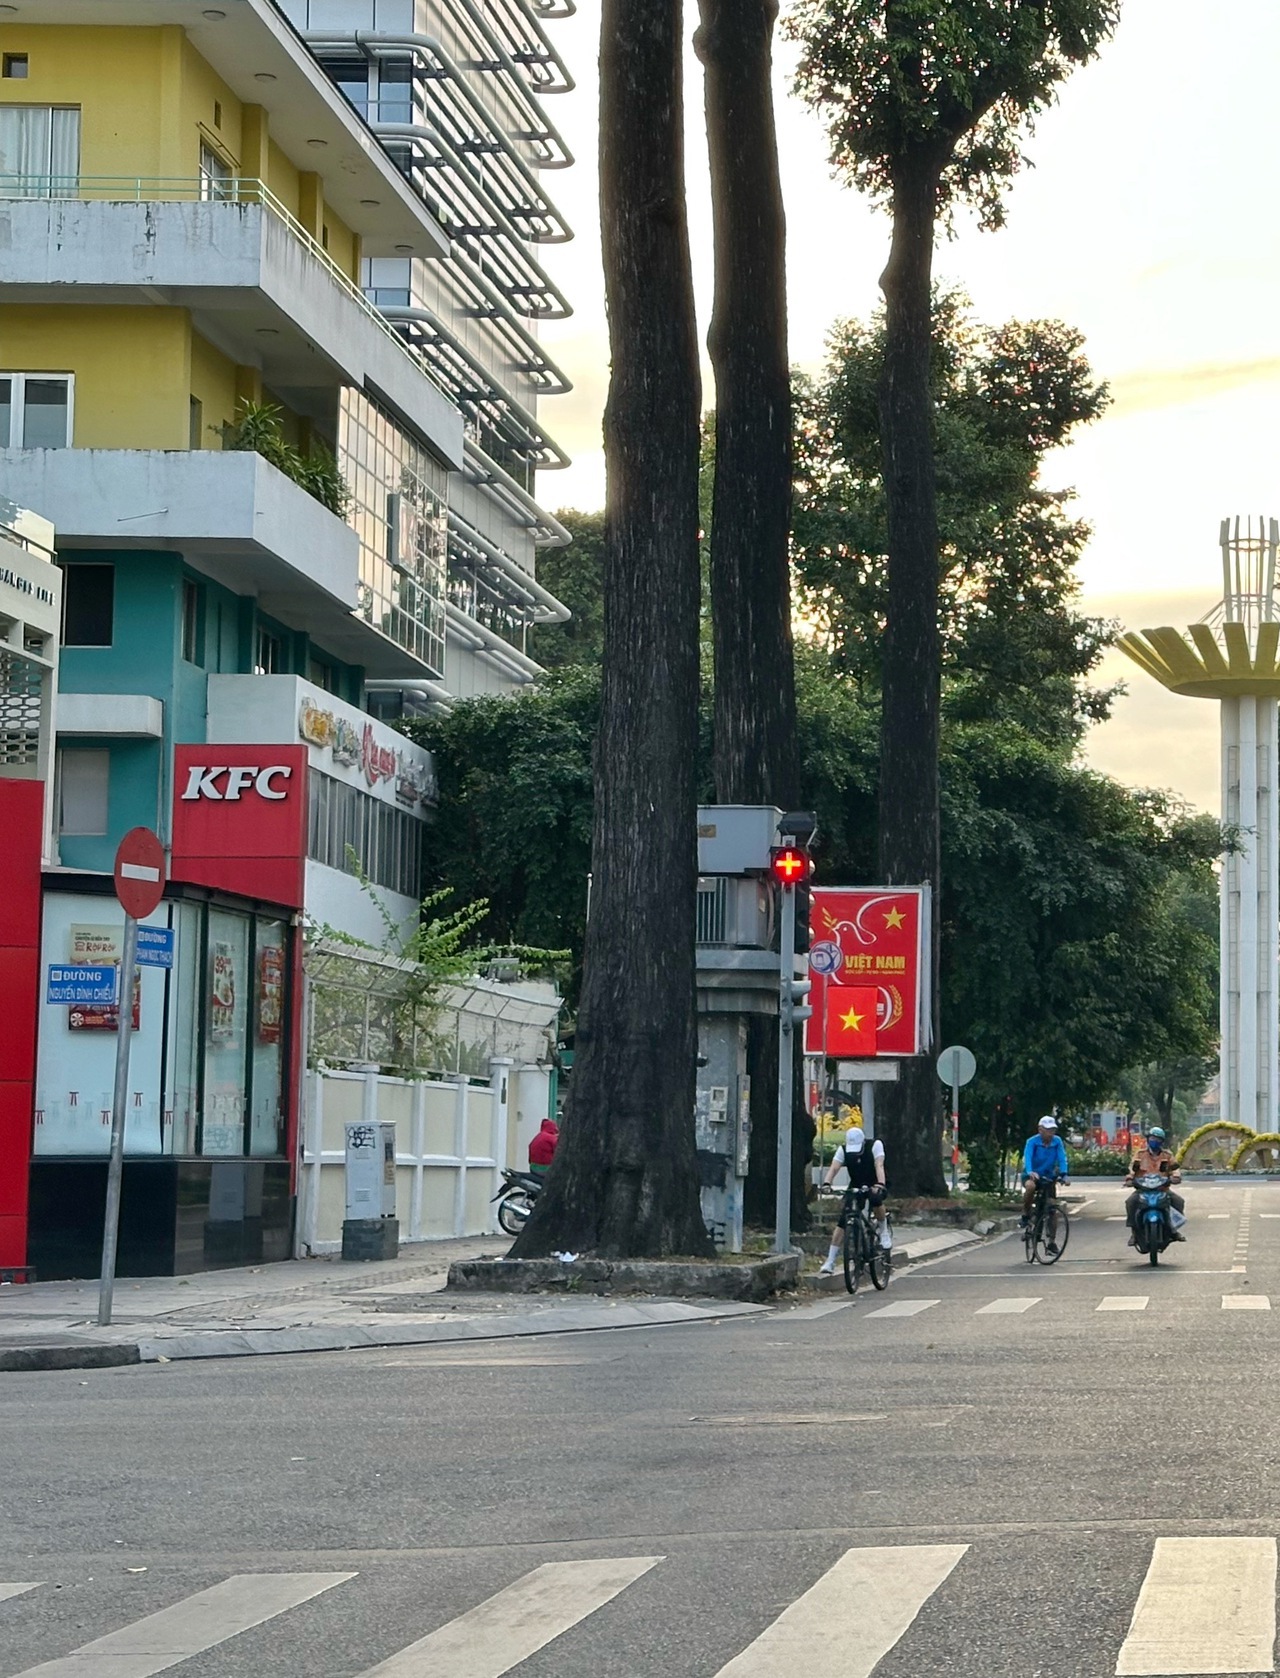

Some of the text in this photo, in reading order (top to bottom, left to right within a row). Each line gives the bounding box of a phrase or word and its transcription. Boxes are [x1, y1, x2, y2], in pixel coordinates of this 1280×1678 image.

[181, 765, 292, 800] KFC
[845, 952, 905, 971] VIỆT NAM
[63, 969, 102, 981] ĐƯỜNG
